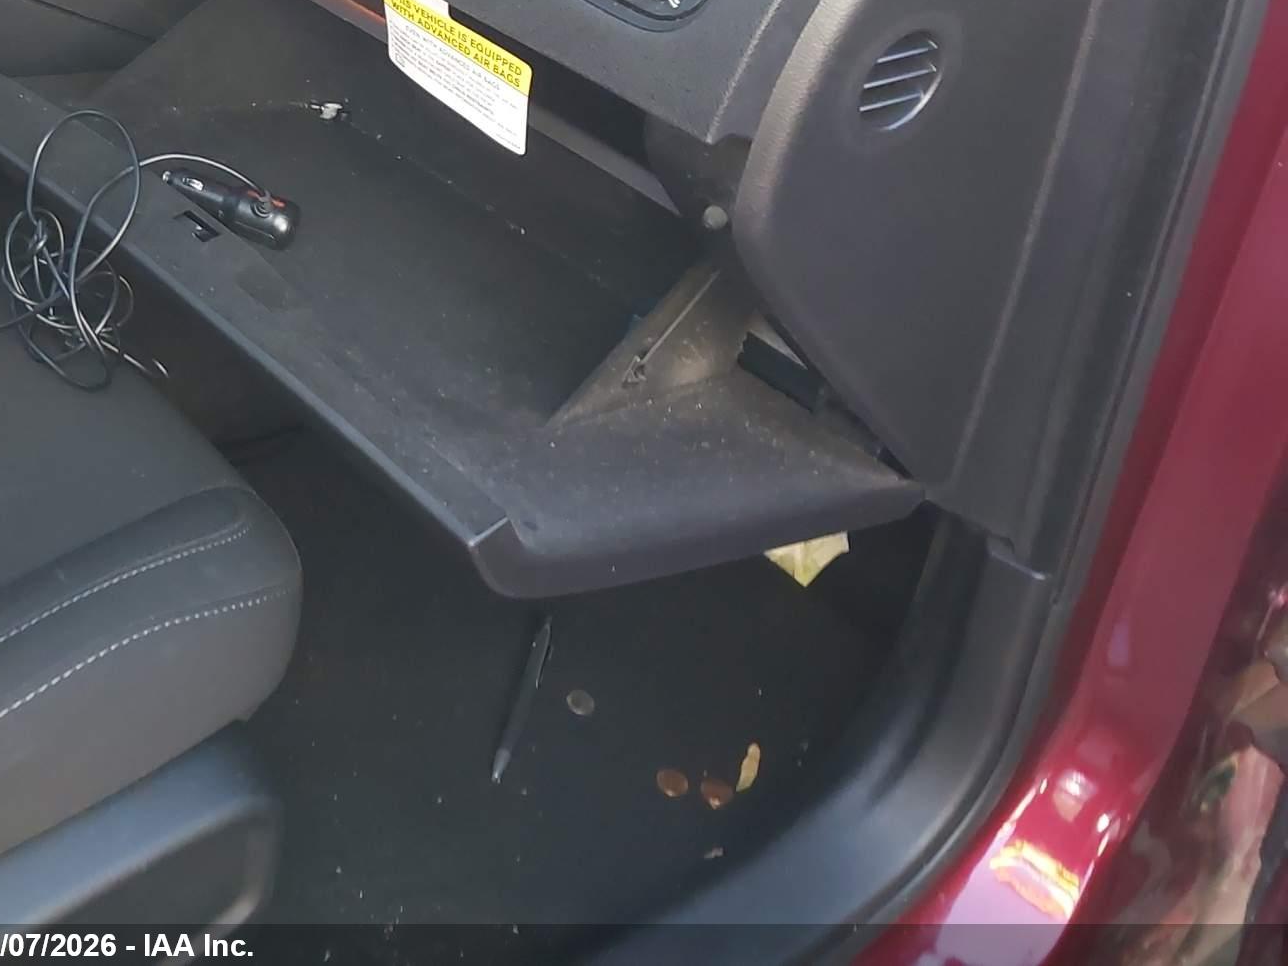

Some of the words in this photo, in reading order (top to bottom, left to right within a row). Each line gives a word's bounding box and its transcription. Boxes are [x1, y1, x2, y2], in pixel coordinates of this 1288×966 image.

[390, 0, 415, 21] WITH
[417, 17, 471, 56] ADVANCED
[473, 53, 491, 70] AIR
[493, 64, 520, 88] BAGS
[413, 4, 456, 36] VEHICLE
[458, 31, 468, 43] IS
[470, 38, 522, 76] EQUIPPED
